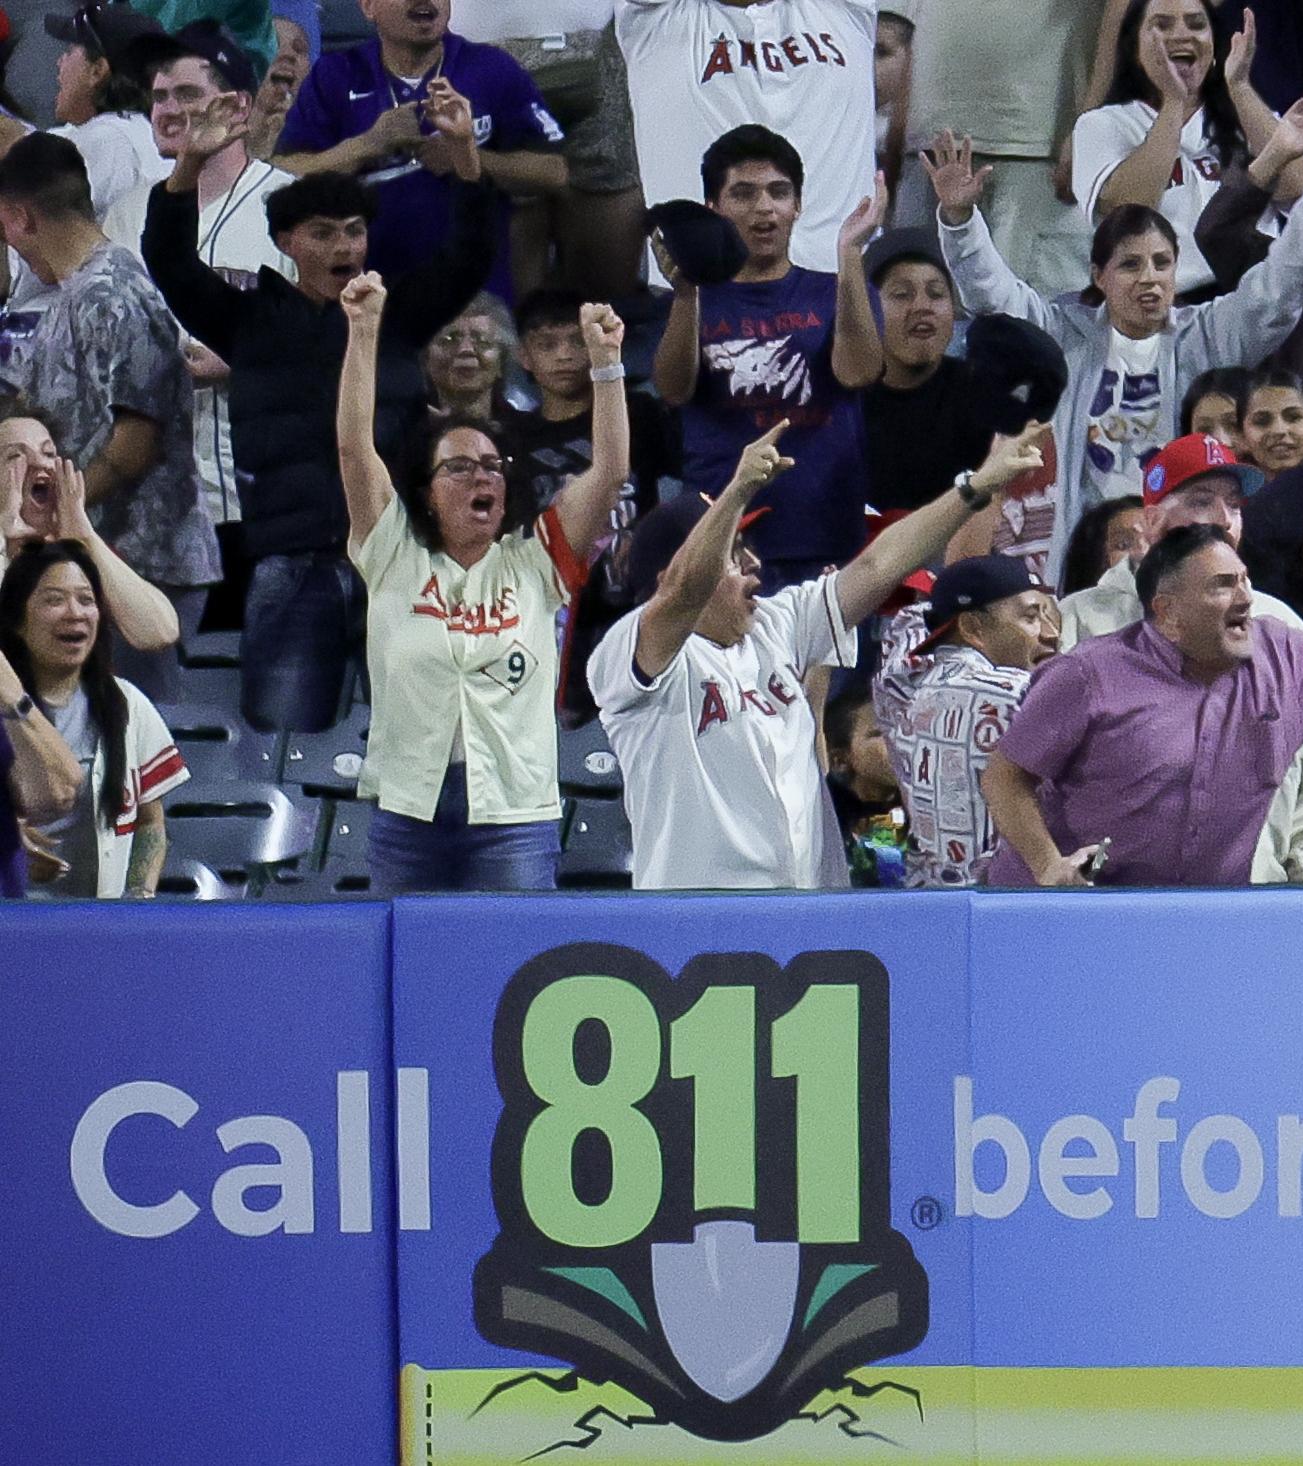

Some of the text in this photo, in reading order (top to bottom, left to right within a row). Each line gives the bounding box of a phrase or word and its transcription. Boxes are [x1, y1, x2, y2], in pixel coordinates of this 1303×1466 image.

[700, 31, 846, 84] ANGELS
[507, 651, 526, 683] 9
[70, 1066, 432, 1239] Call
[520, 974, 862, 1248] 811
